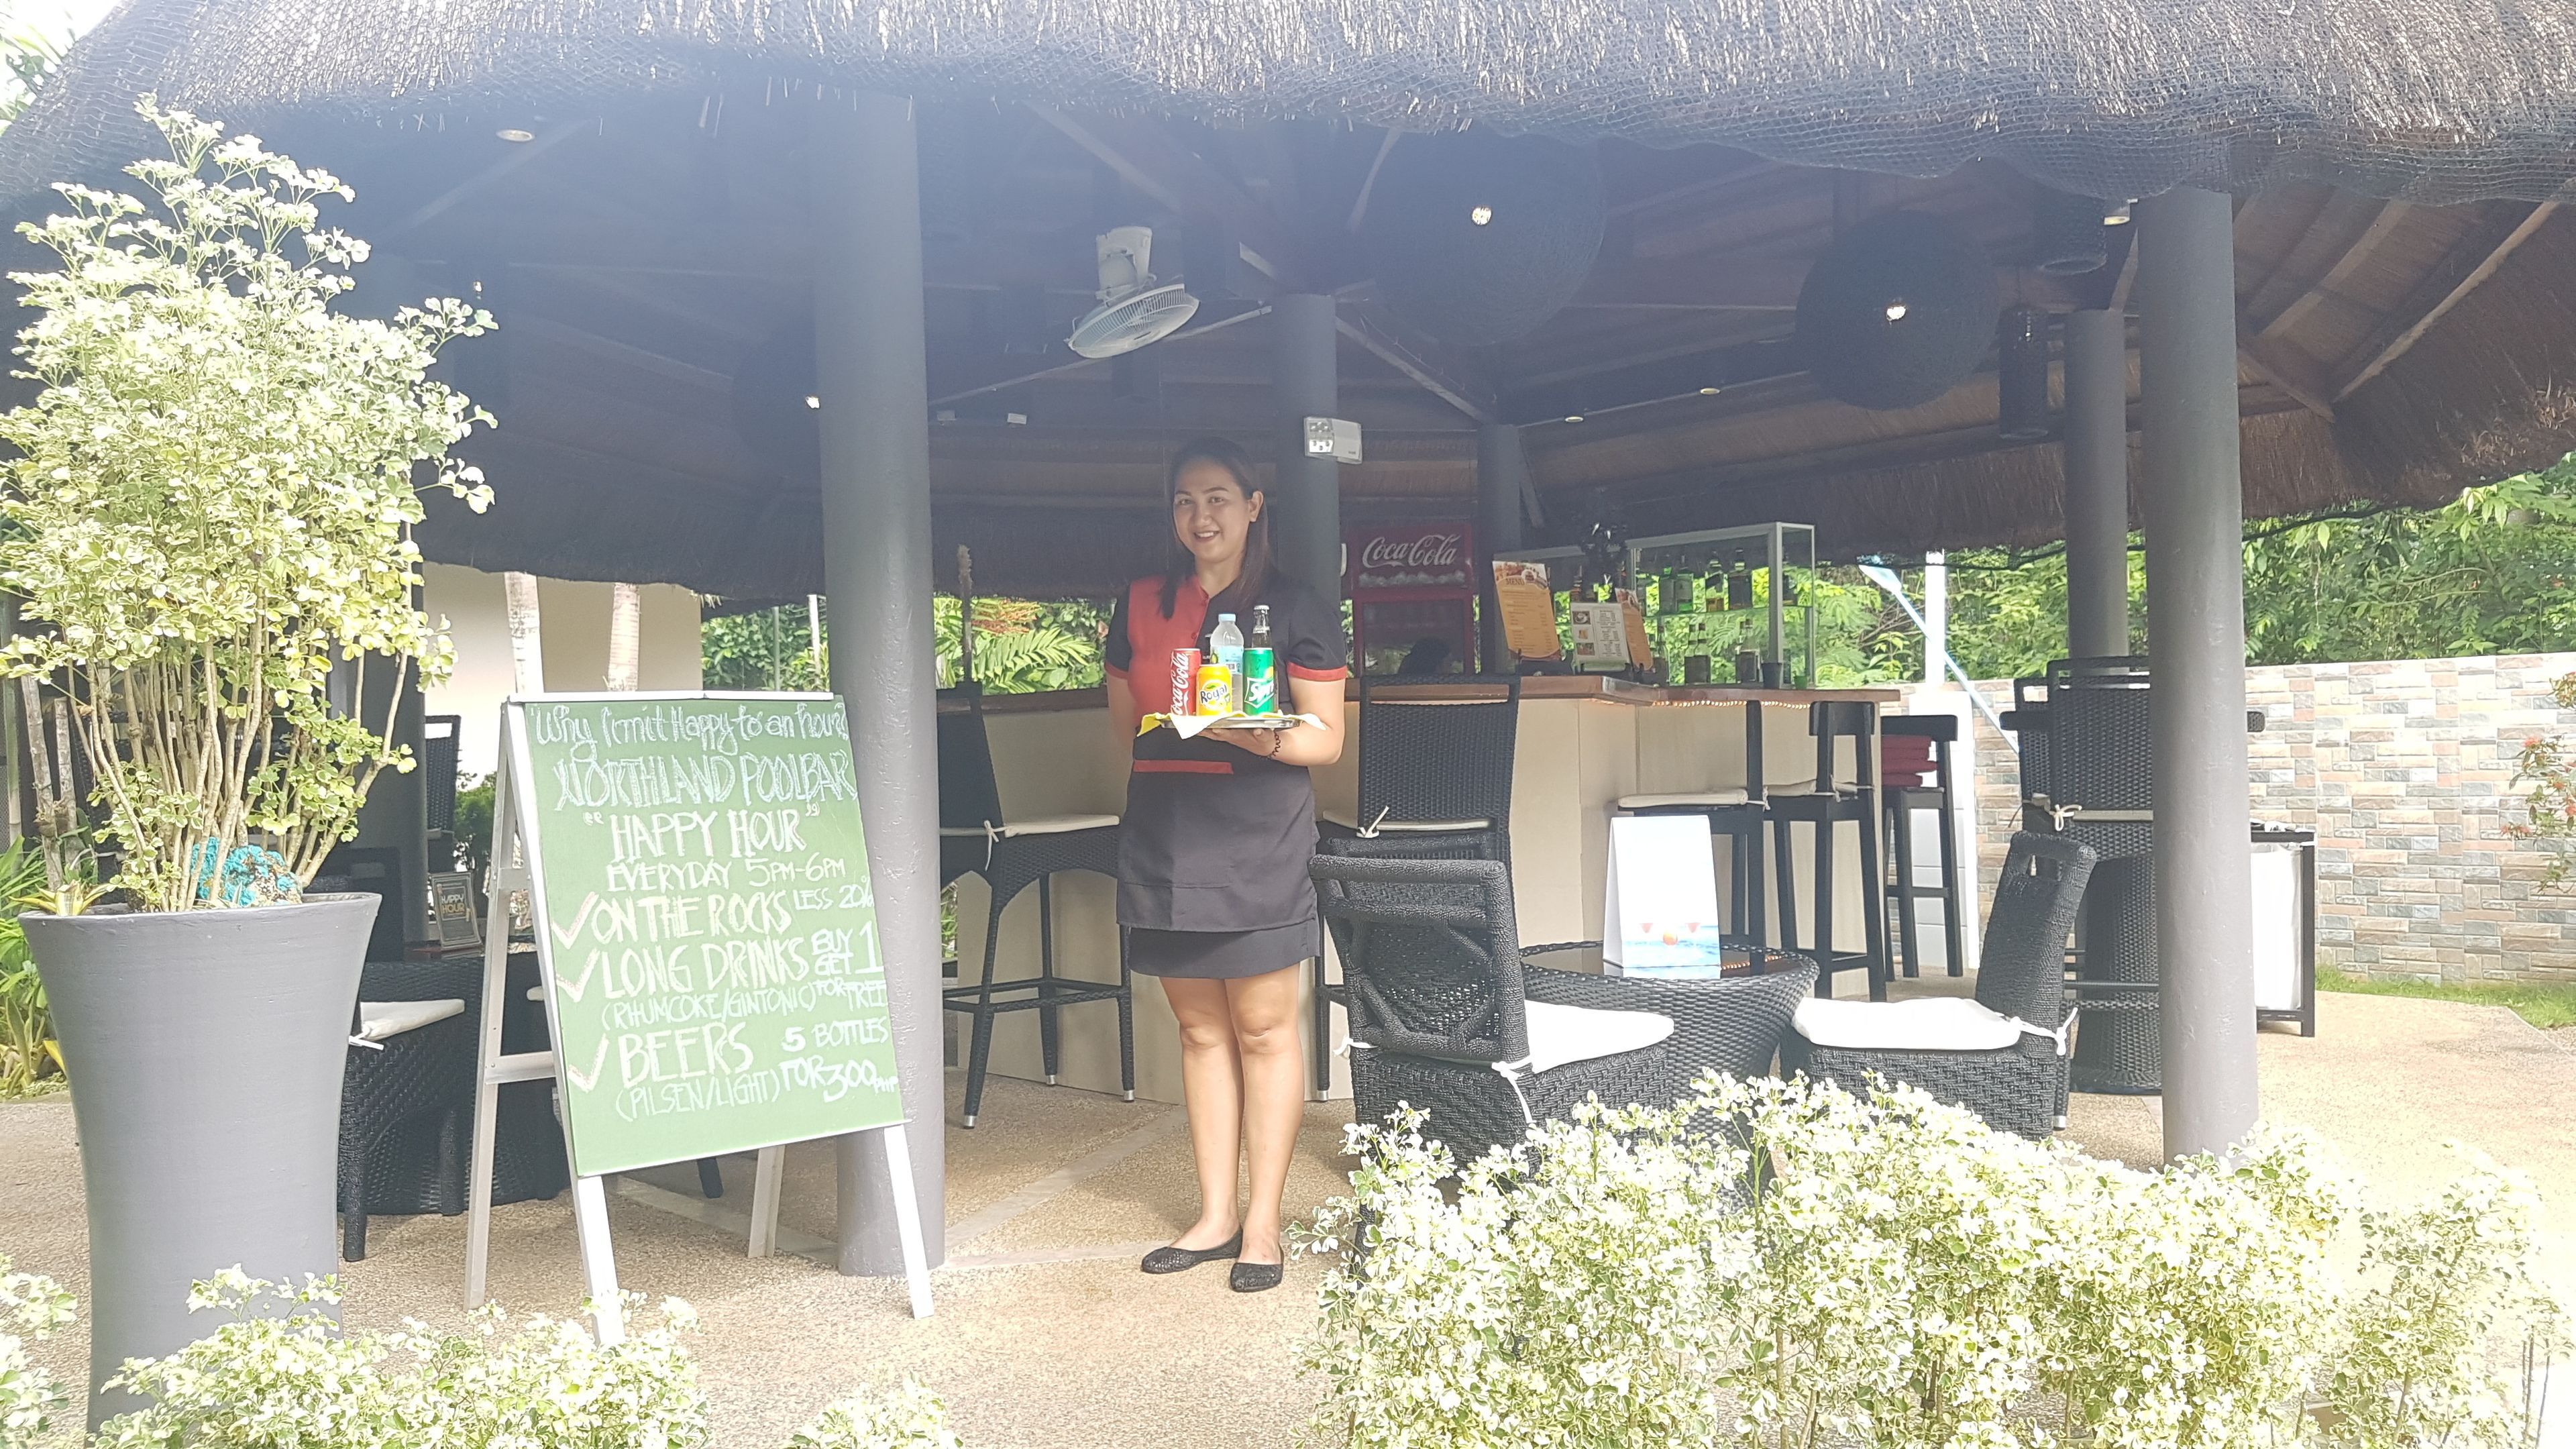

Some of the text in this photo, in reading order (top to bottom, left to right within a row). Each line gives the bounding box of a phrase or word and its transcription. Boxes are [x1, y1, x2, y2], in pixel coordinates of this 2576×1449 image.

[1362, 535, 1460, 568] Coca-Cola
[1199, 684, 1228, 704] Royal
[670, 705, 739, 756] Happy
[765, 715, 794, 738] an
[553, 754, 736, 811] NORTHLAND
[607, 852, 846, 892] EVERYDAY 5PM-6PM
[441, 894, 464, 904] HAPPY
[441, 902, 465, 913] HOUR
[591, 875, 875, 944] ON THE ROCKS LESS 20%
[600, 920, 885, 1000] LONG DRINKS BUY 1
[814, 952, 854, 976] GET
[813, 977, 847, 998] FOR
[843, 979, 889, 1011] FREE
[618, 1015, 889, 1089] BEERS 5 BOTTLES
[779, 1054, 825, 1091] FOR
